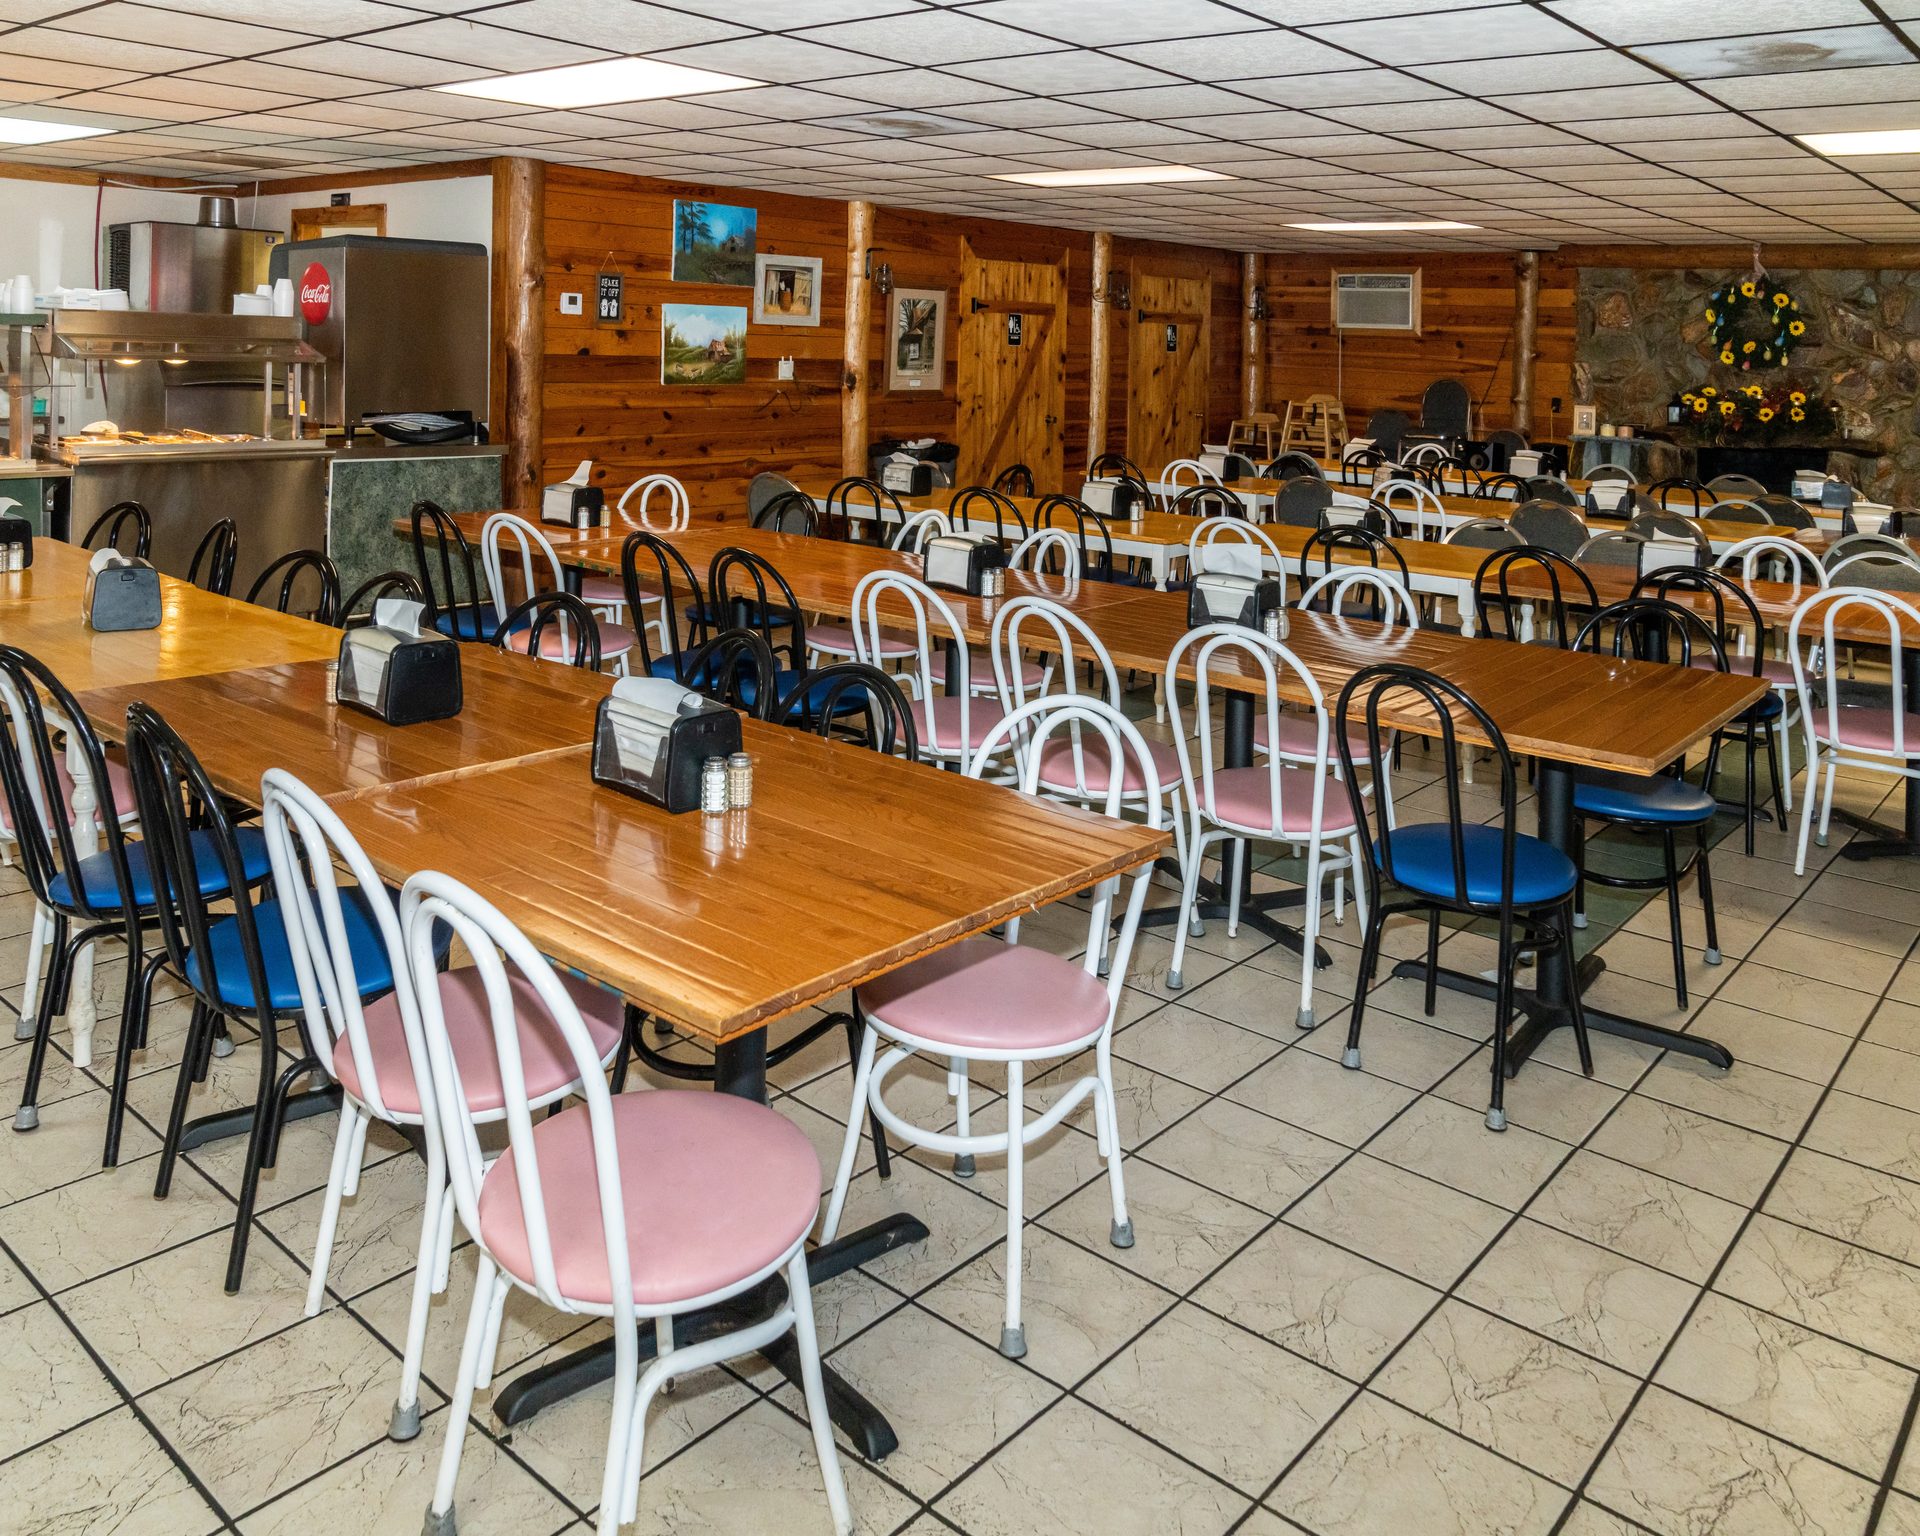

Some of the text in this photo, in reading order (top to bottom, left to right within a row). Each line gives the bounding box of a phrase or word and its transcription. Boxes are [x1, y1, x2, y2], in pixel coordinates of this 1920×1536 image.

[601, 278, 619, 287] SHAKE
[601, 288, 619, 297] IT OFF
